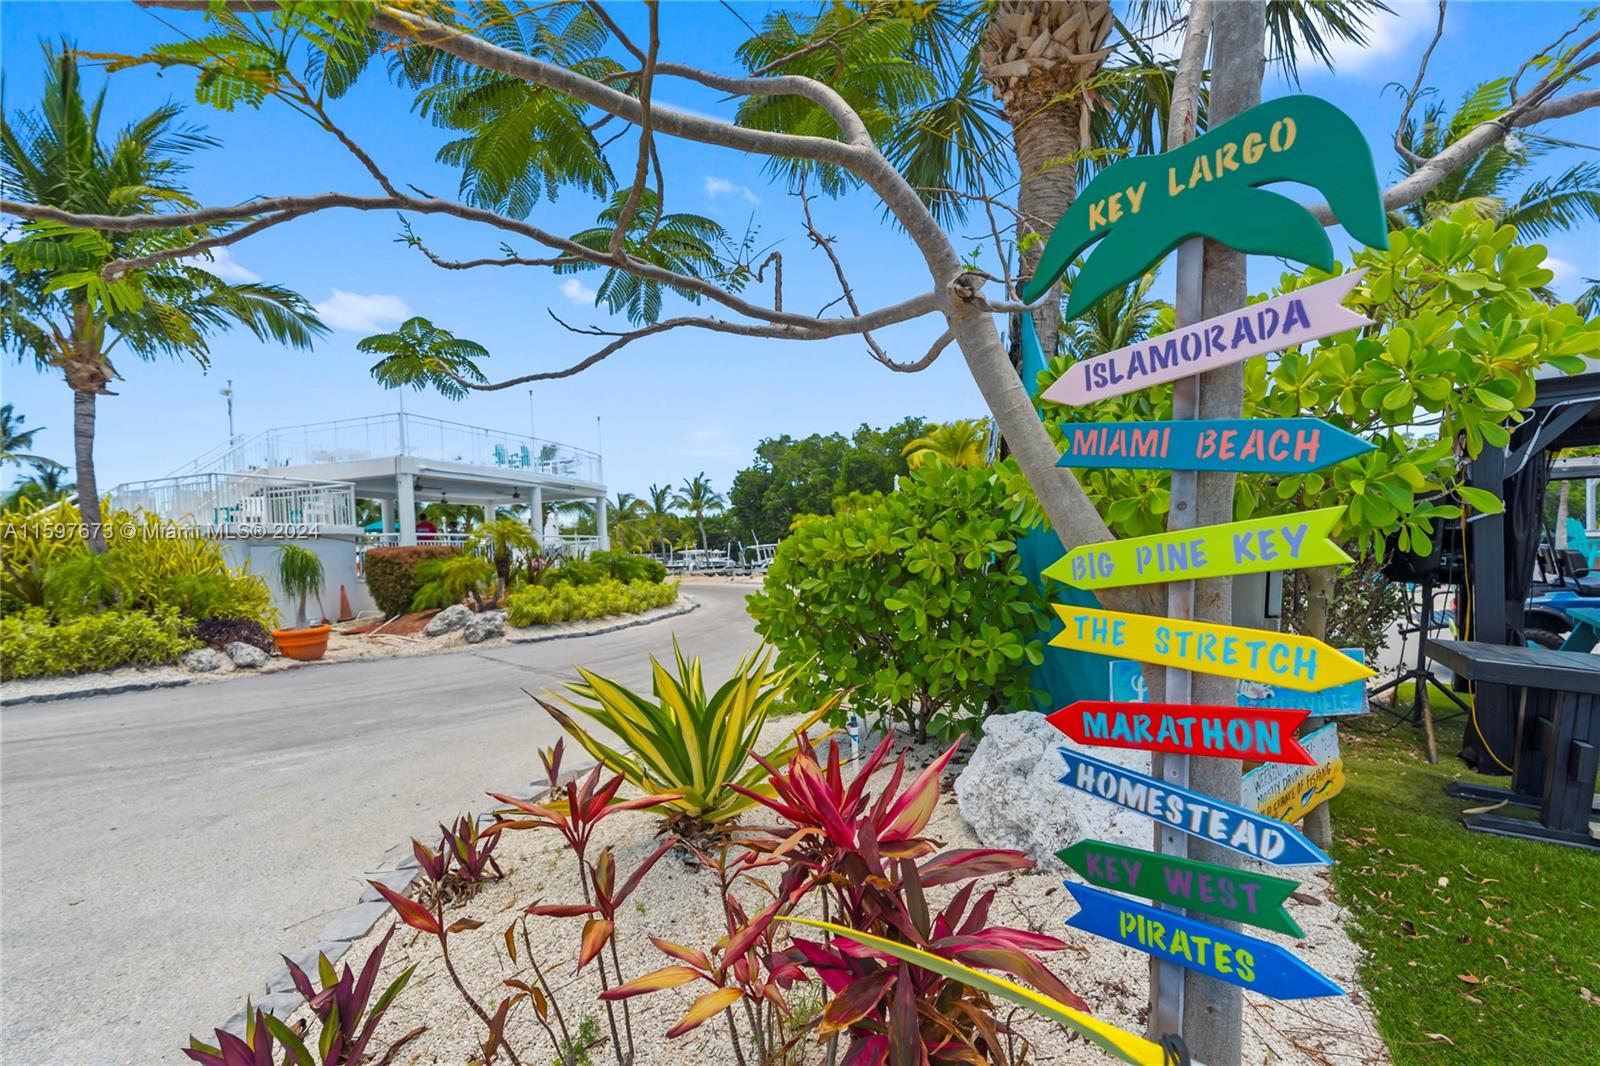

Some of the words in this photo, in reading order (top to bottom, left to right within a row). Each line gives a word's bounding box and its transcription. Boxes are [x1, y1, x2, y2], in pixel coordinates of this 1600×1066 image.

[1088, 181, 1147, 232] KEY
[1168, 116, 1297, 197] LARGO
[1084, 299, 1310, 393] ISLAMORADA
[1071, 427, 1172, 459] MIAMI
[1195, 427, 1320, 464] BEACH
[1071, 552, 1115, 581] BIG
[1136, 538, 1209, 575] PINE
[1233, 524, 1309, 565] KEY
[1074, 616, 1126, 647] THE
[1154, 626, 1318, 681] STRETCH
[1082, 711, 1281, 755] MARATHON
[1306, 762, 1331, 787] FISHING
[1076, 762, 1286, 861] HOMESTEAD
[1086, 851, 1142, 887] KEY
[1164, 868, 1261, 914] WEST
[1119, 911, 1256, 983] PIRATES
